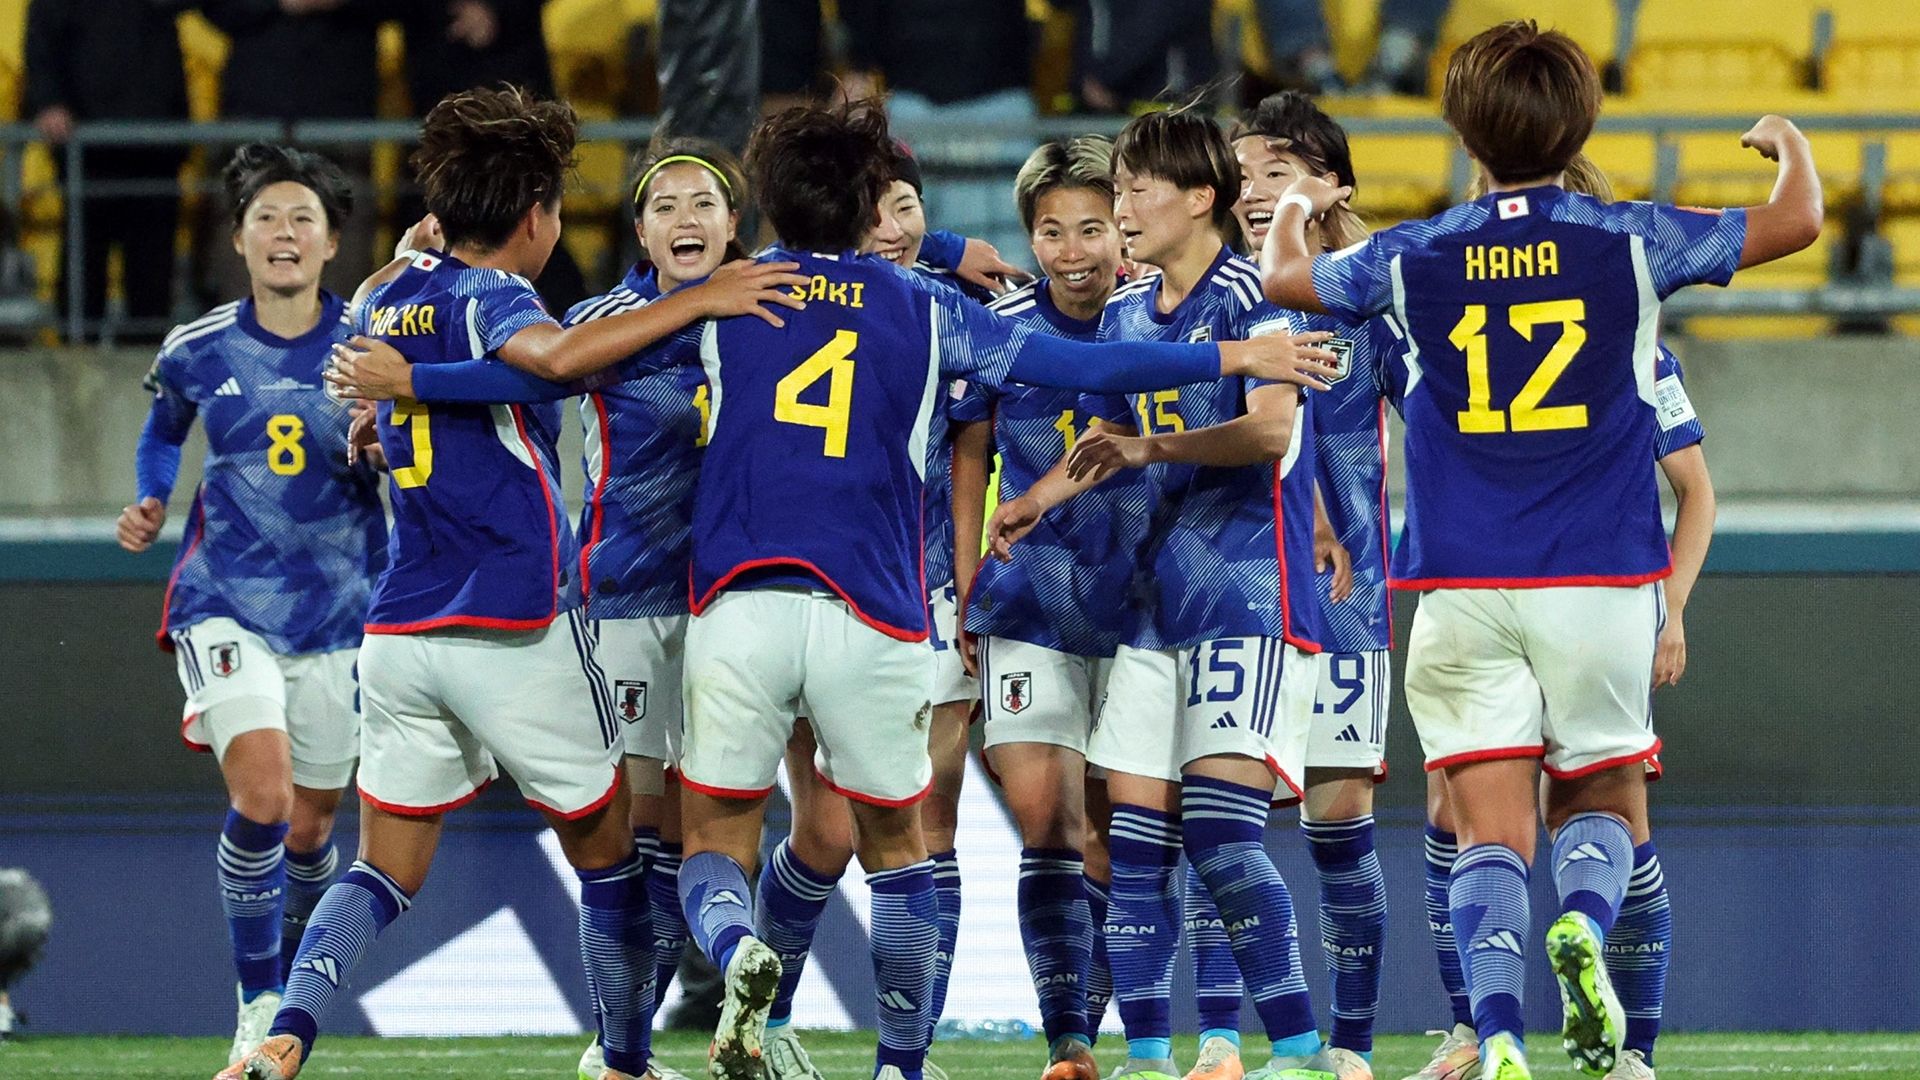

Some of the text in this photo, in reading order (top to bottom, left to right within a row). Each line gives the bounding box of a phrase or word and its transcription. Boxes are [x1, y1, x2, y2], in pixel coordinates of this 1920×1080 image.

[1465, 241, 1559, 281] HANA
[788, 275, 865, 308] SAKI
[368, 304, 436, 336] MOEKA
[1448, 299, 1588, 433] 12
[773, 329, 858, 458] 4
[691, 385, 711, 447] 1
[1137, 390, 1185, 437] 15
[266, 414, 307, 476] 8
[1187, 640, 1245, 708] 15
[222, 887, 281, 902] JAPAN
[1103, 925, 1156, 935] PAN
[1184, 918, 1225, 931] APA
[1227, 915, 1261, 933] PAN
[1321, 938, 1373, 957] JAPAN
[1604, 941, 1665, 954] JAPAN
[1034, 973, 1079, 989] PAN
